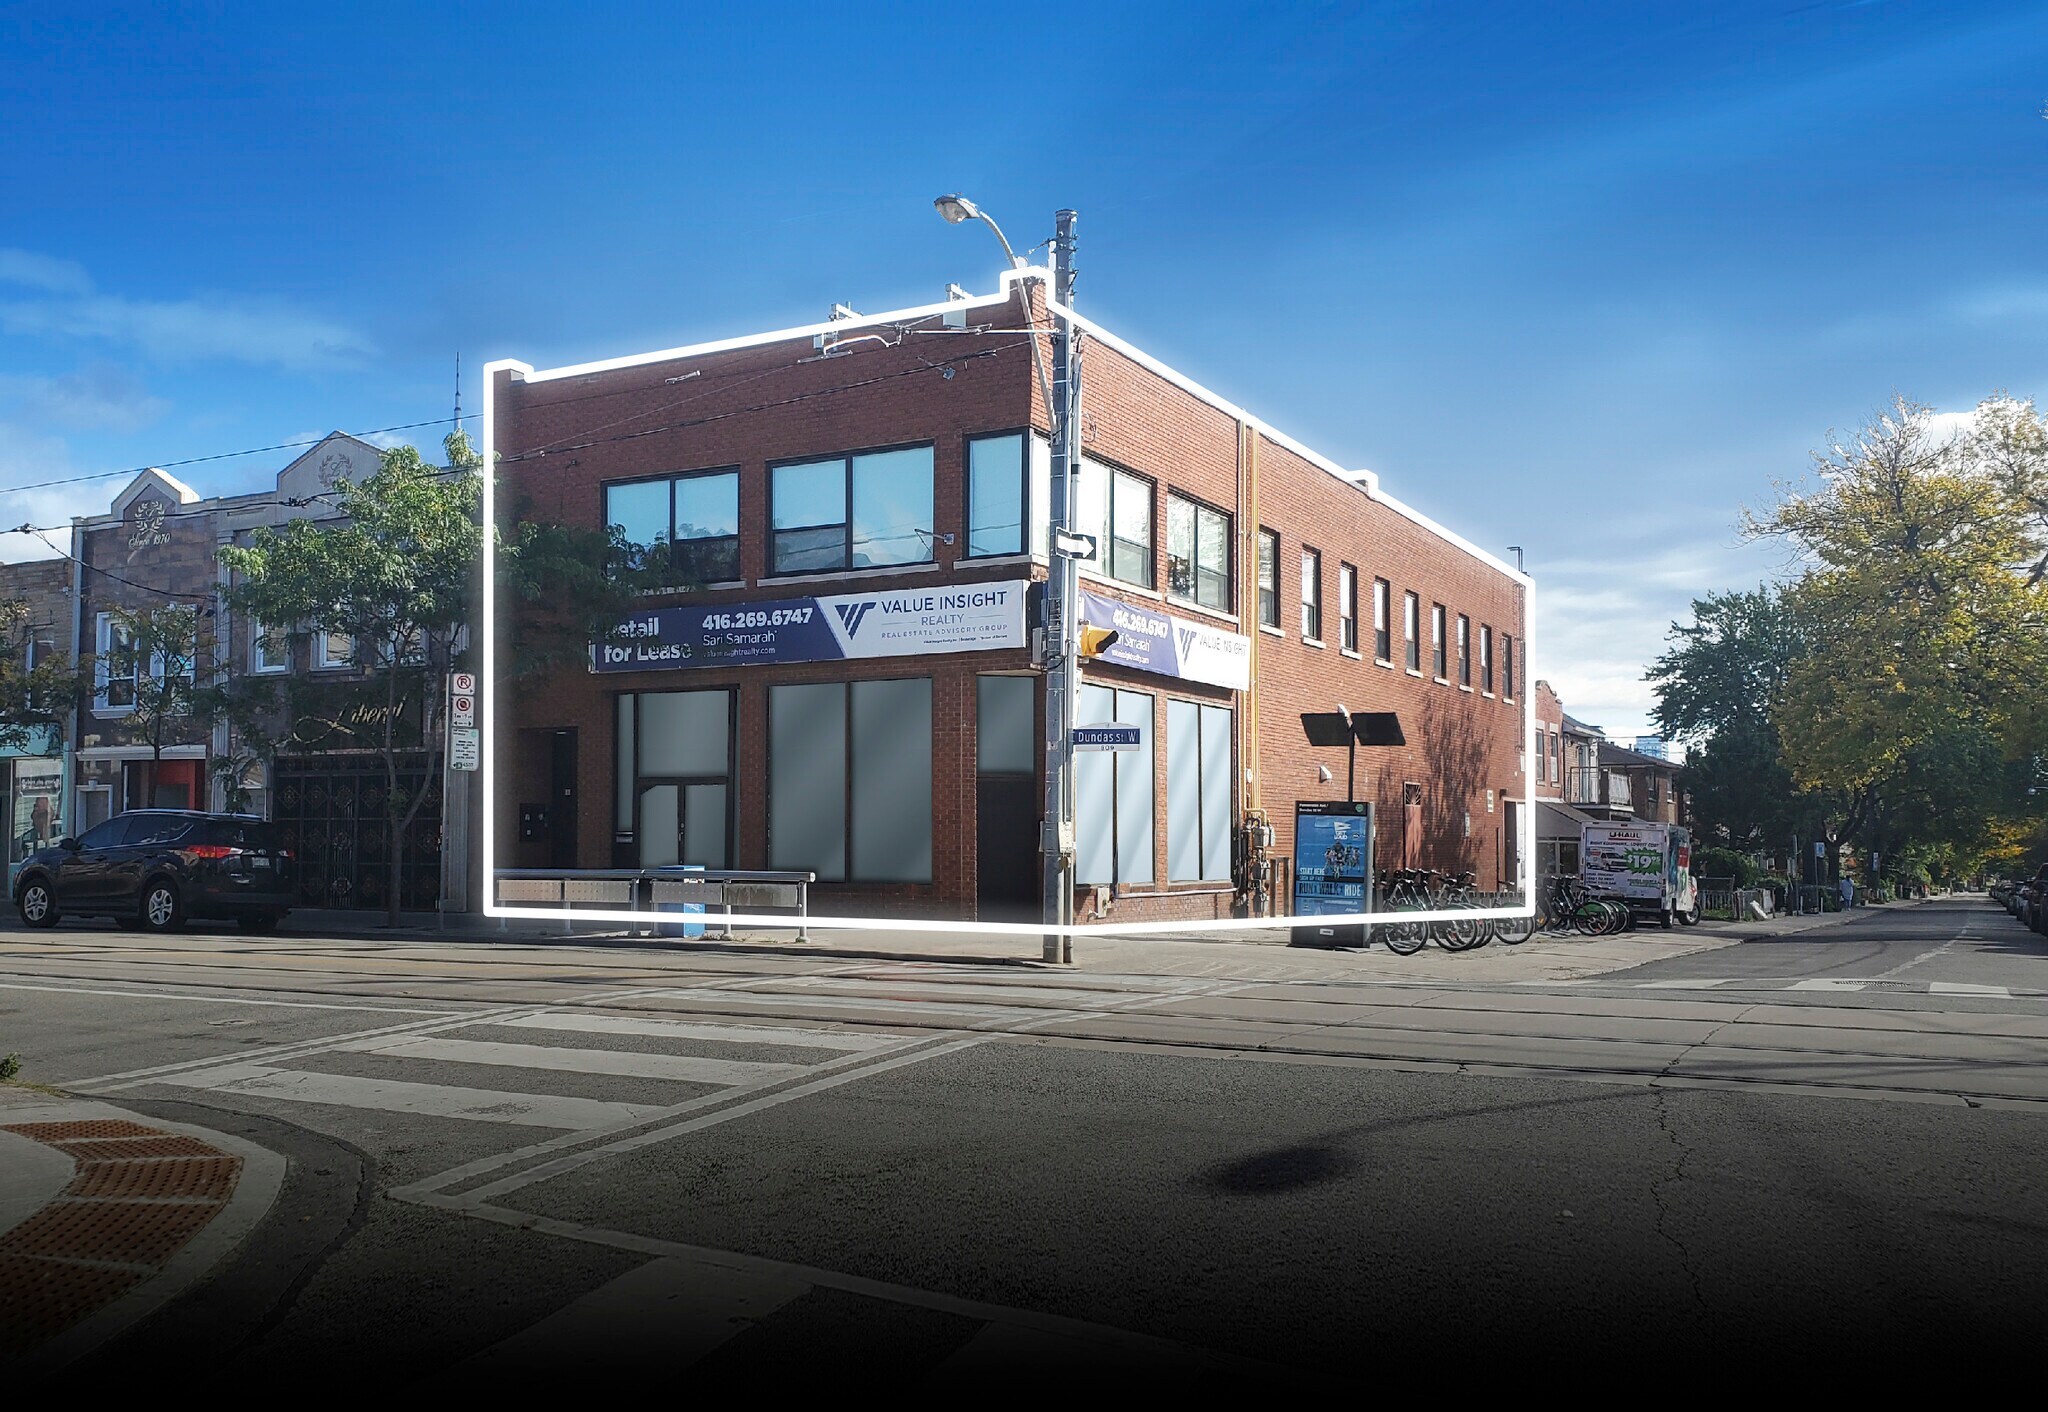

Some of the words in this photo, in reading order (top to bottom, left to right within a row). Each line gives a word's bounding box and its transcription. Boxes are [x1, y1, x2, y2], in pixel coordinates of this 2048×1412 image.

[881, 597, 934, 613] VALUE
[940, 591, 1007, 609] INSIGHT
[702, 607, 813, 630] 416.269.6747
[921, 614, 964, 626] REALTY
[606, 617, 659, 638] etail
[935, 627, 976, 635] ADVISORY
[979, 624, 1007, 632] GROUP
[703, 634, 723, 646] Sari
[726, 630, 775, 645] Samarah
[604, 645, 632, 663] for
[1221, 640, 1247, 657] NSGHT
[1078, 731, 1114, 743] Dundas
[1127, 731, 1136, 742] W
[1344, 884, 1361, 897] RIDE
